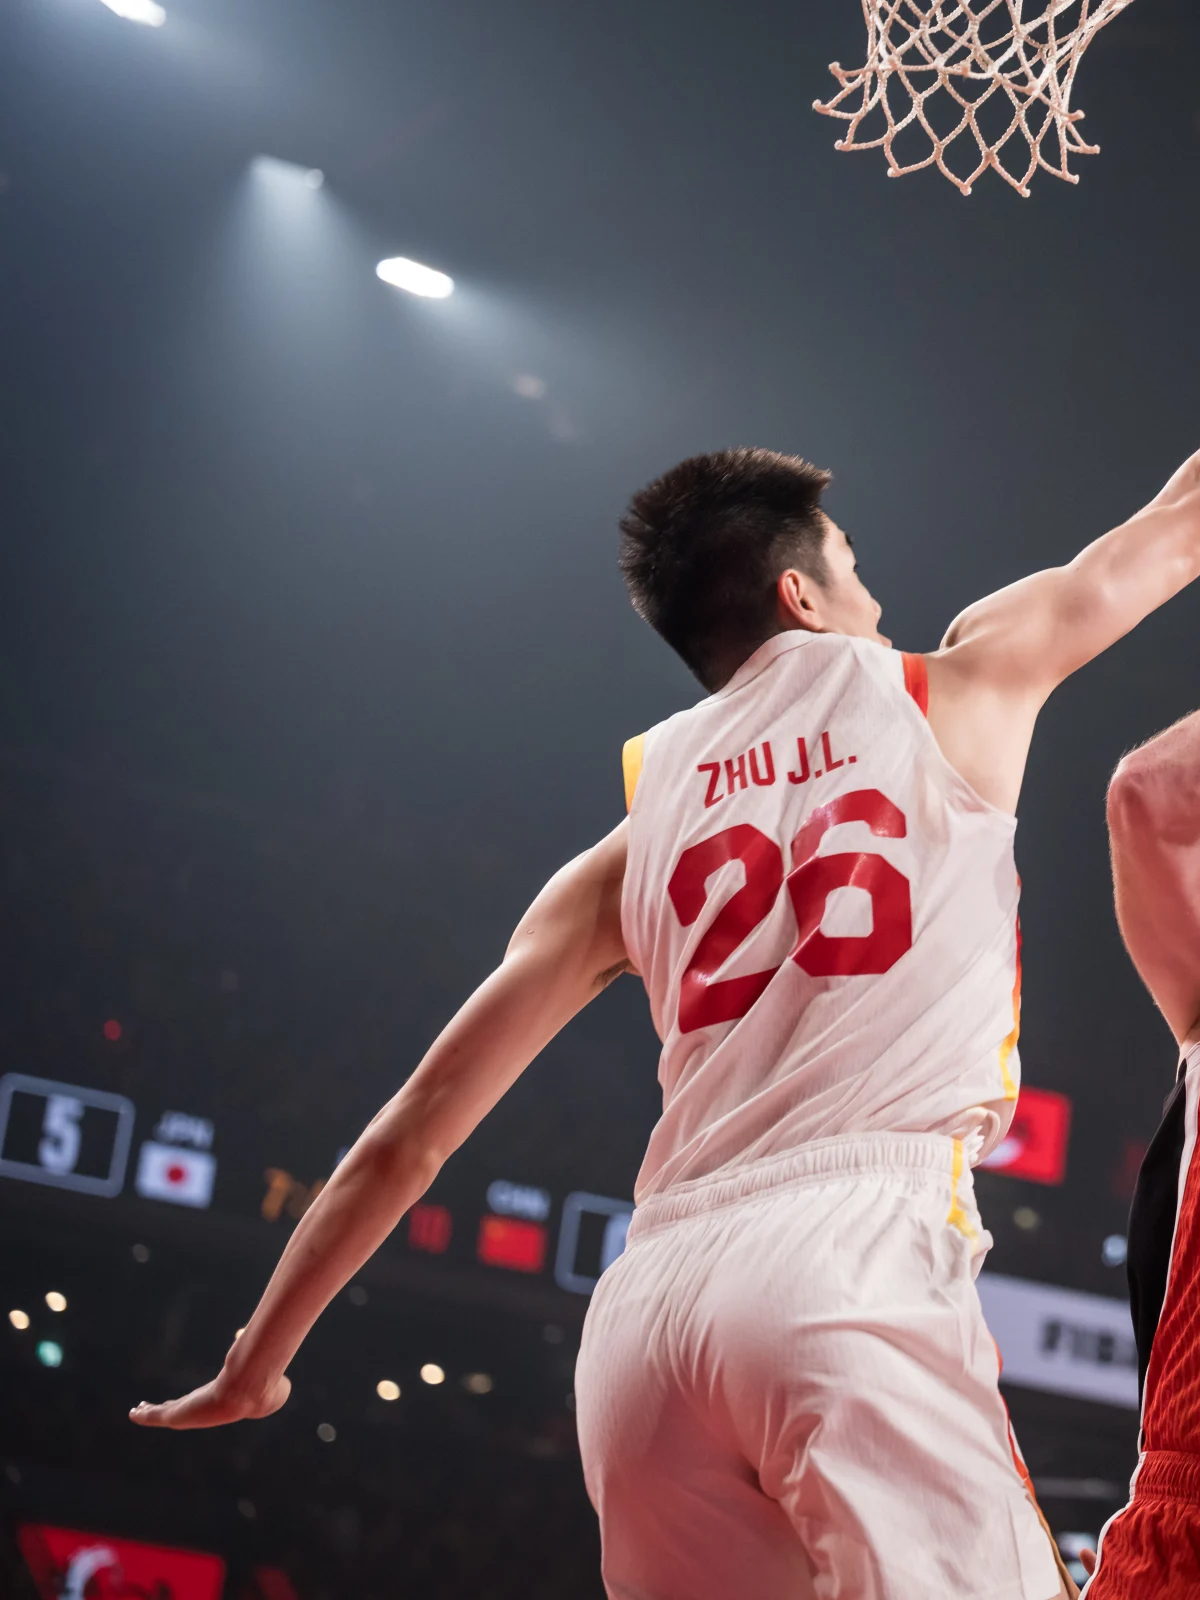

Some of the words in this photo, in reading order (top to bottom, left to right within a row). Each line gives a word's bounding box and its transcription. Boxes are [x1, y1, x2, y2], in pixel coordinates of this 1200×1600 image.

[697, 741, 776, 808] ZHU
[787, 731, 858, 785] J.L.
[667, 788, 913, 1034] 26
[38, 1092, 84, 1176] 5
